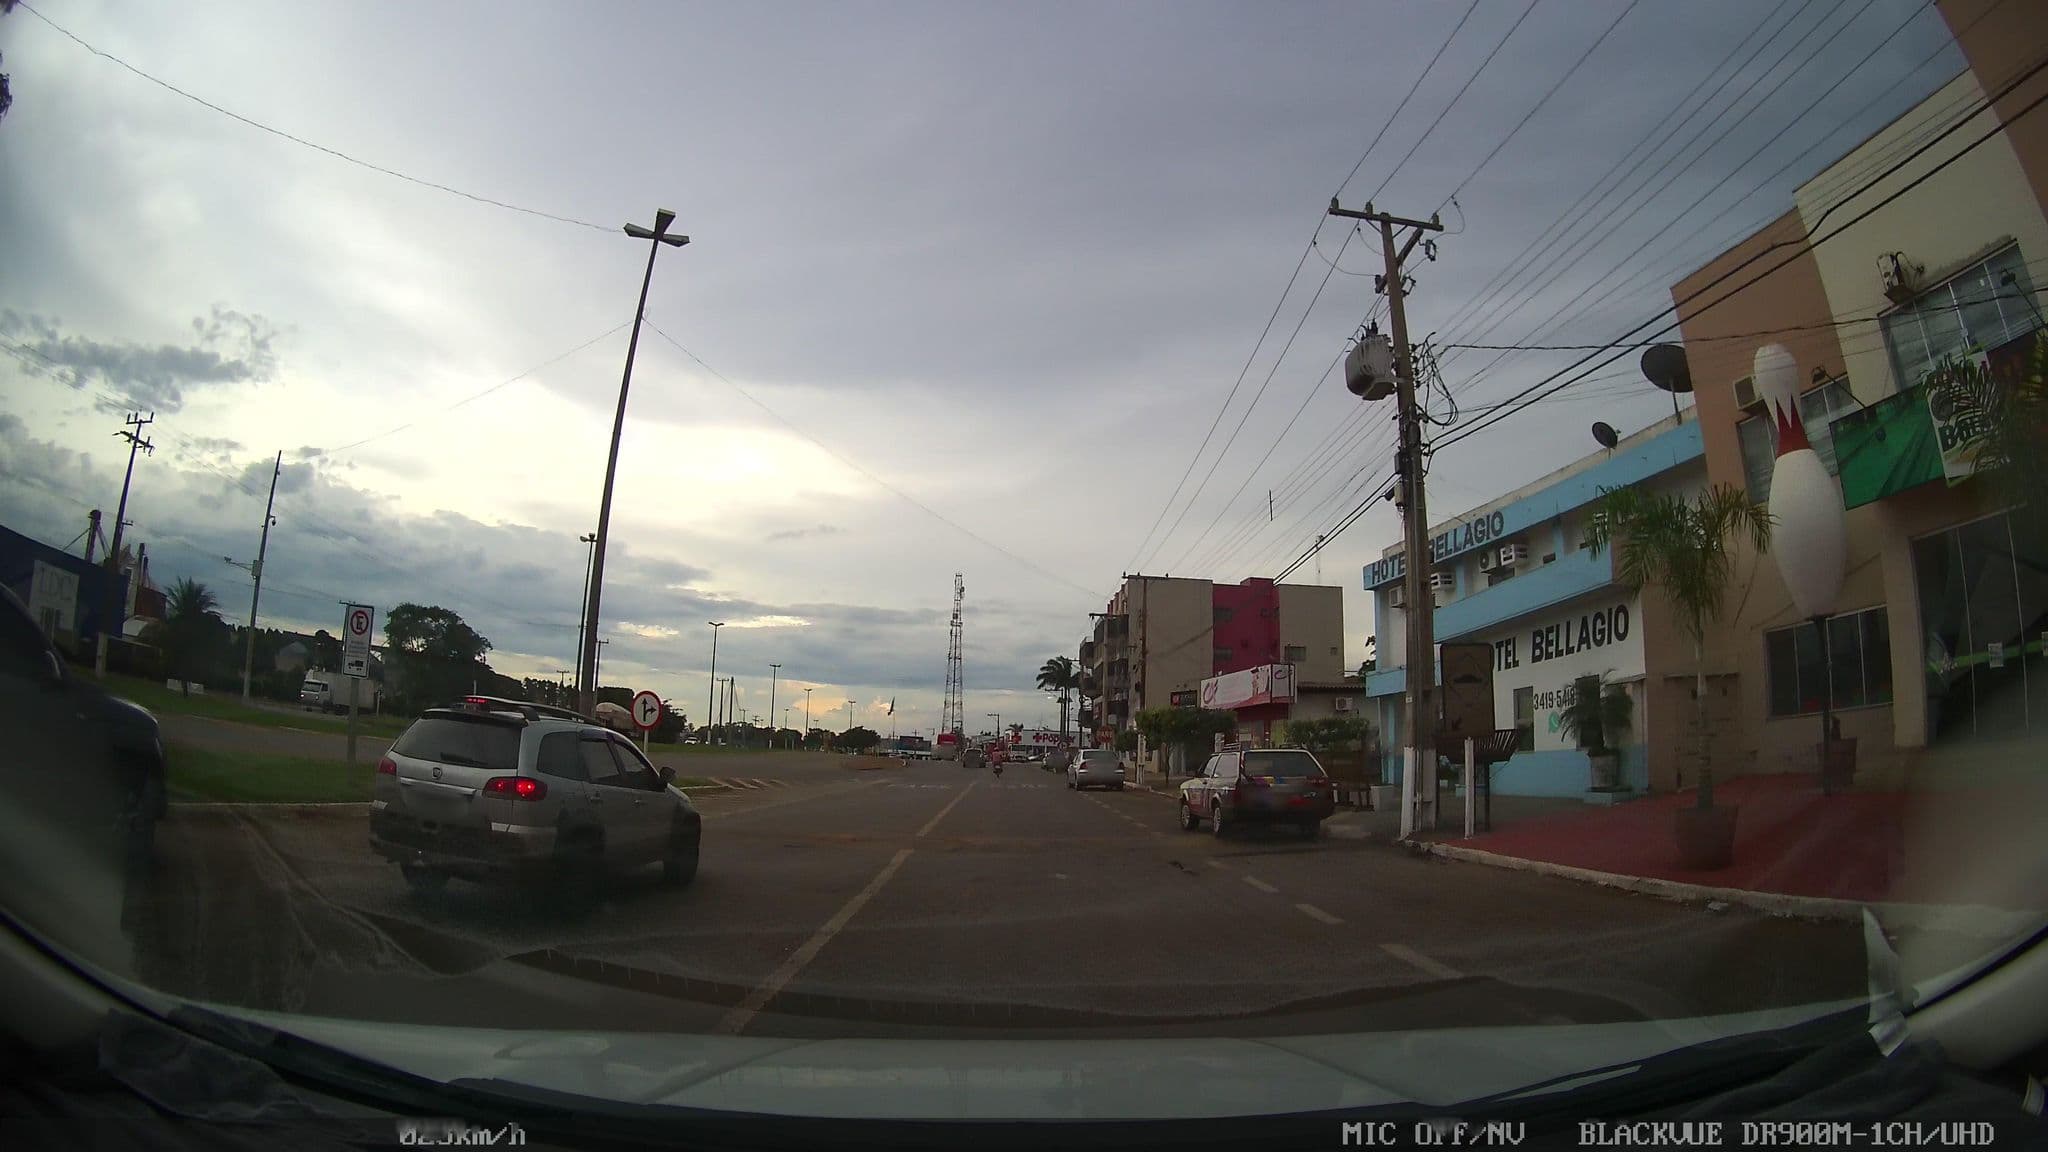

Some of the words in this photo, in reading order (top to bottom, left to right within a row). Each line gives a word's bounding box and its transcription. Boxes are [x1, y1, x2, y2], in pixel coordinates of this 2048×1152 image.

[1371, 551, 1406, 585] HOTE
[1495, 636, 1520, 672] TEL
[1531, 604, 1630, 664] BELLAGIO
